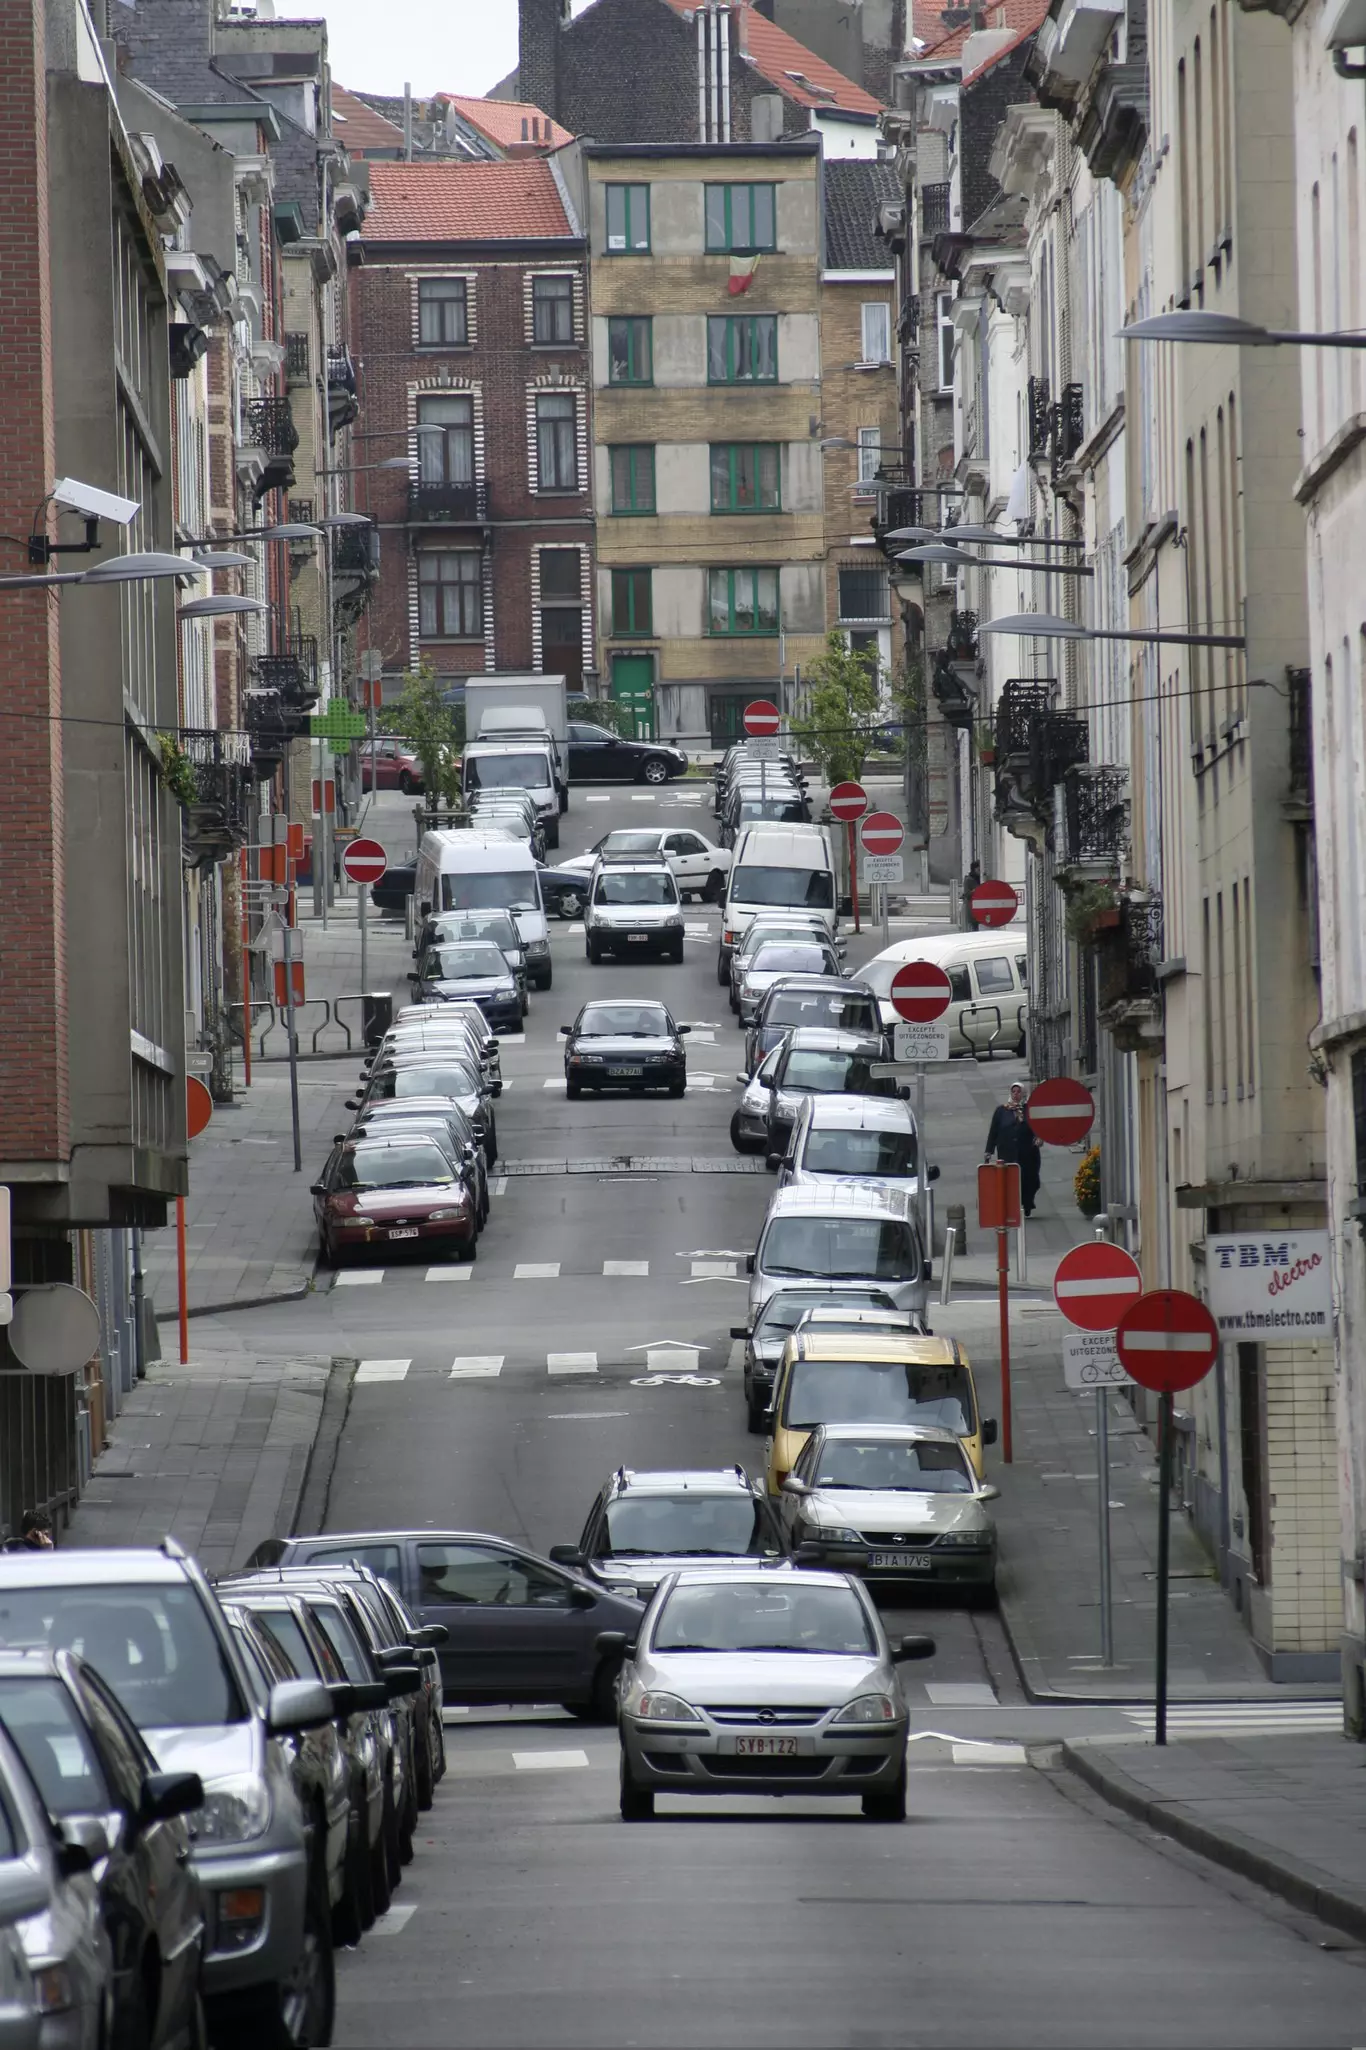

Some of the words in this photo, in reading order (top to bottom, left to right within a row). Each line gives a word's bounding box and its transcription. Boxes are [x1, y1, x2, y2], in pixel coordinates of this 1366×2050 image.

[1215, 1243, 1290, 1268] TBM
[1267, 1252, 1323, 1297] electro
[1218, 1309, 1325, 1329] www.tbmelectro.com
[1082, 1336, 1117, 1346] EXCEPT
